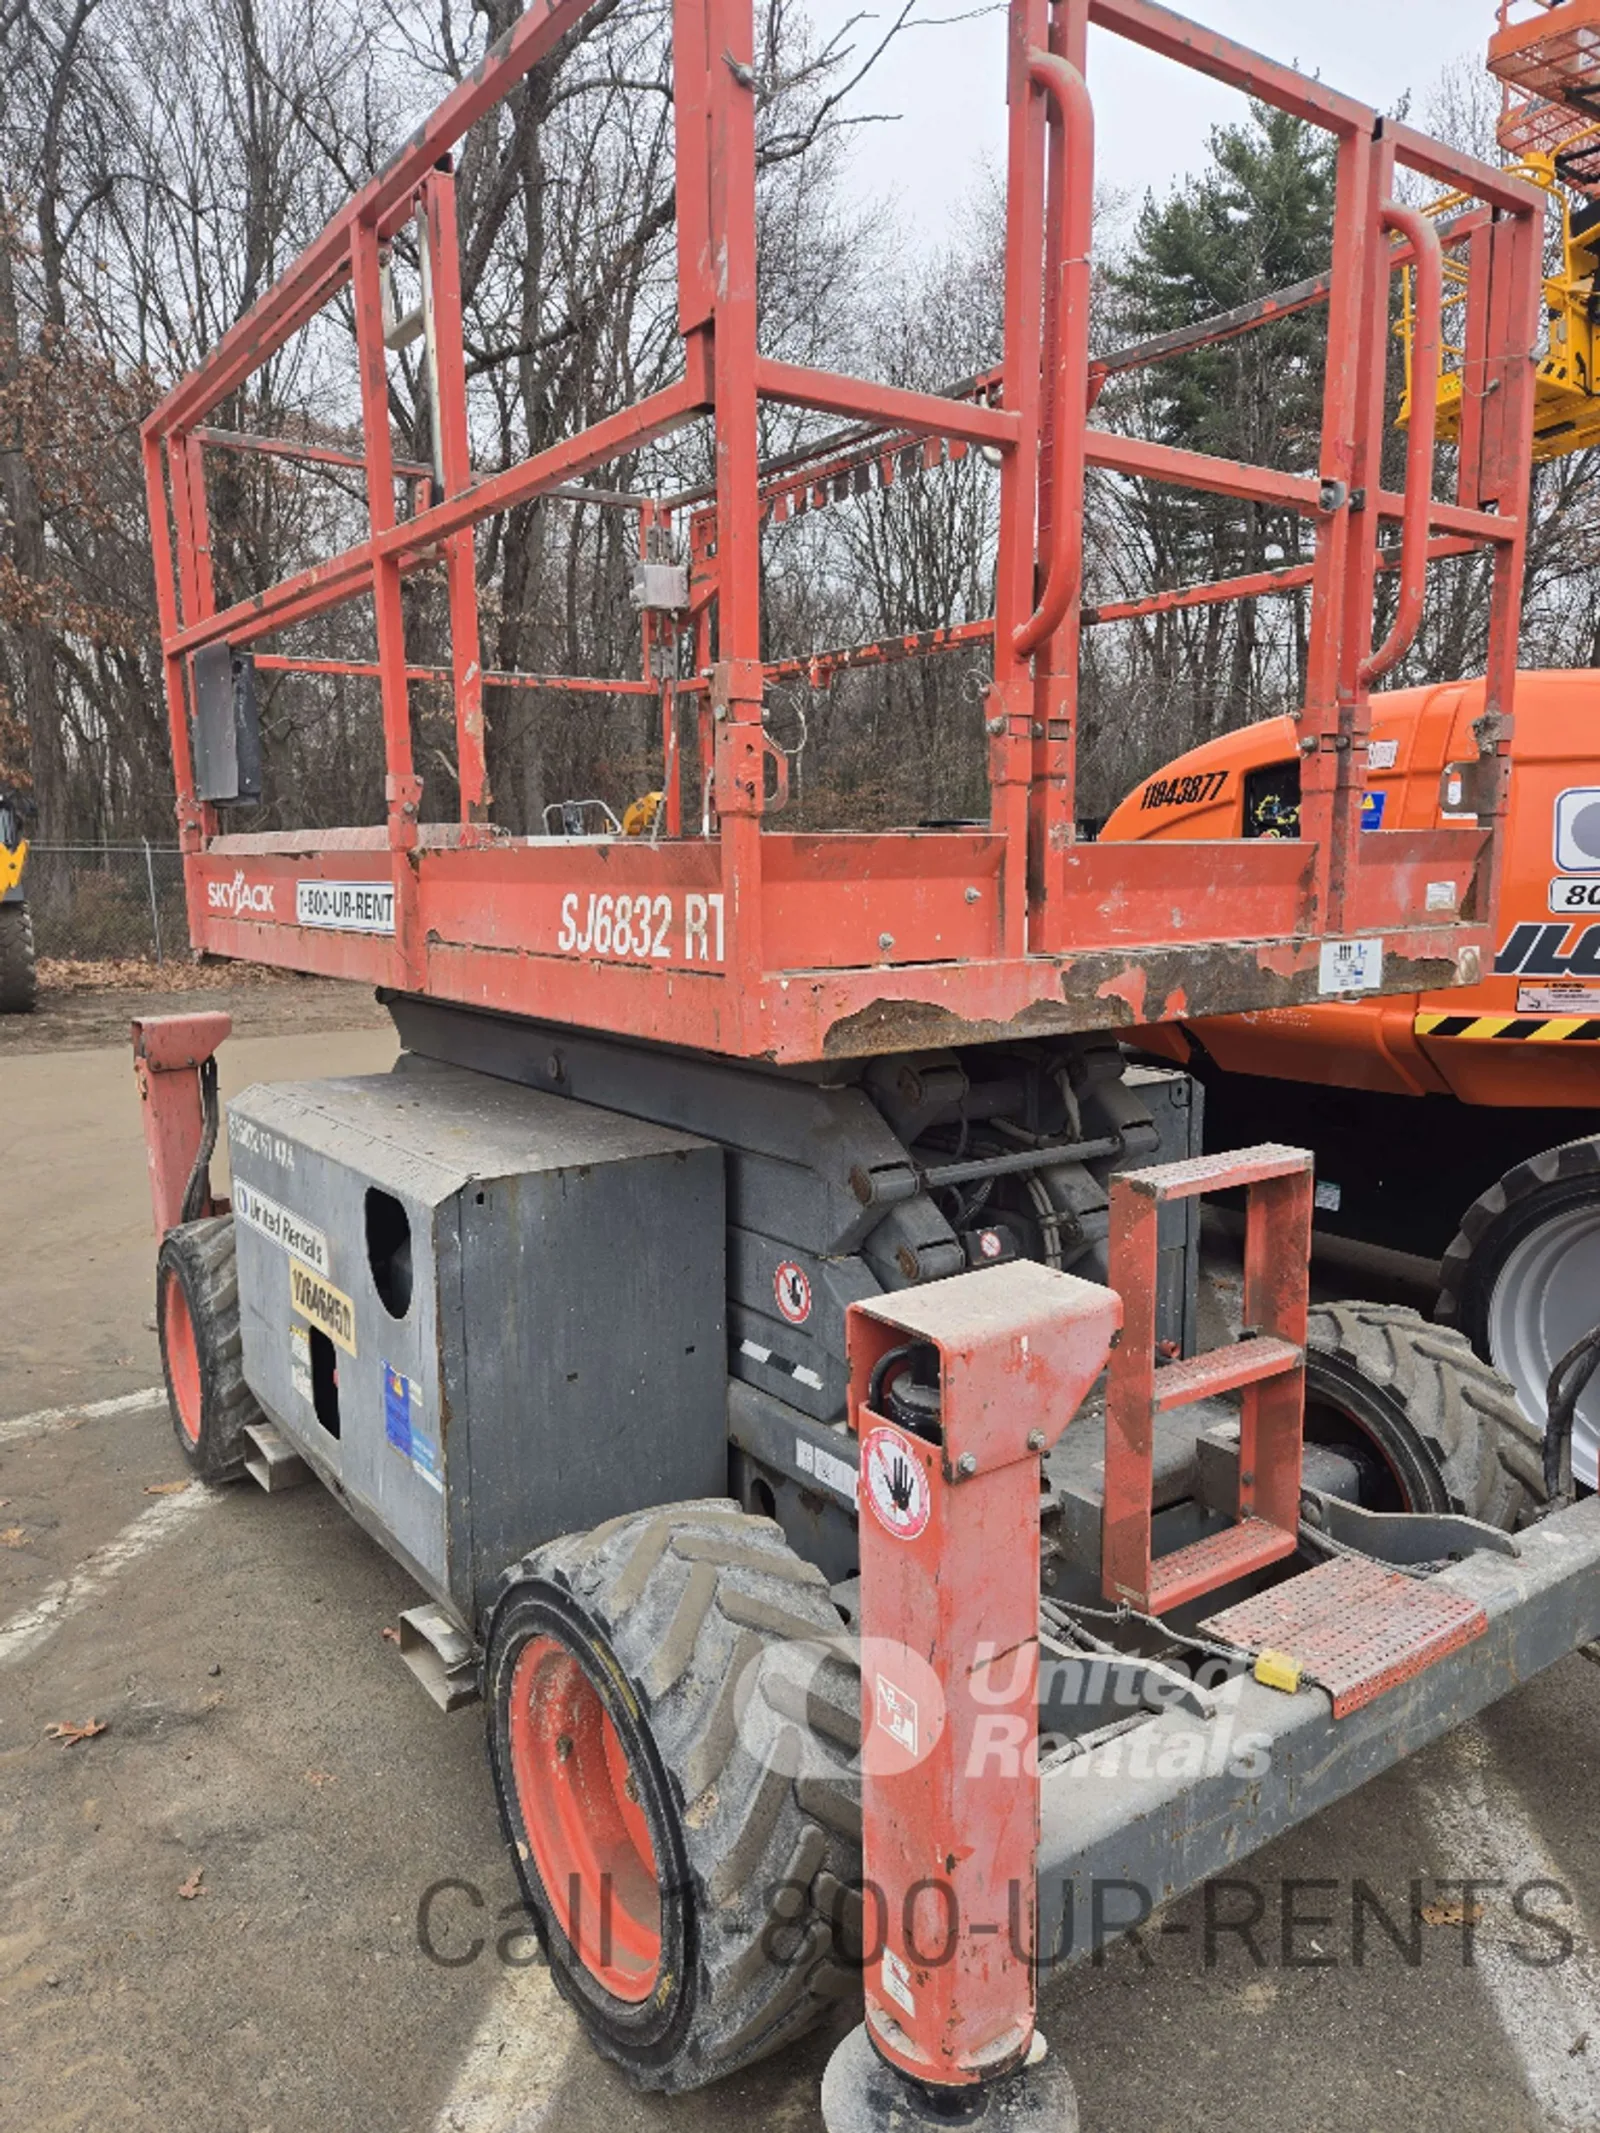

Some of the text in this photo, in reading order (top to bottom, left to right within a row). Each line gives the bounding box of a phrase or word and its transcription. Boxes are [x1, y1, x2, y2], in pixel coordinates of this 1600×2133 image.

[1139, 771, 1230, 811] 11843877
[207, 869, 275, 916] SKYJACK
[557, 893, 673, 958] SJ6832
